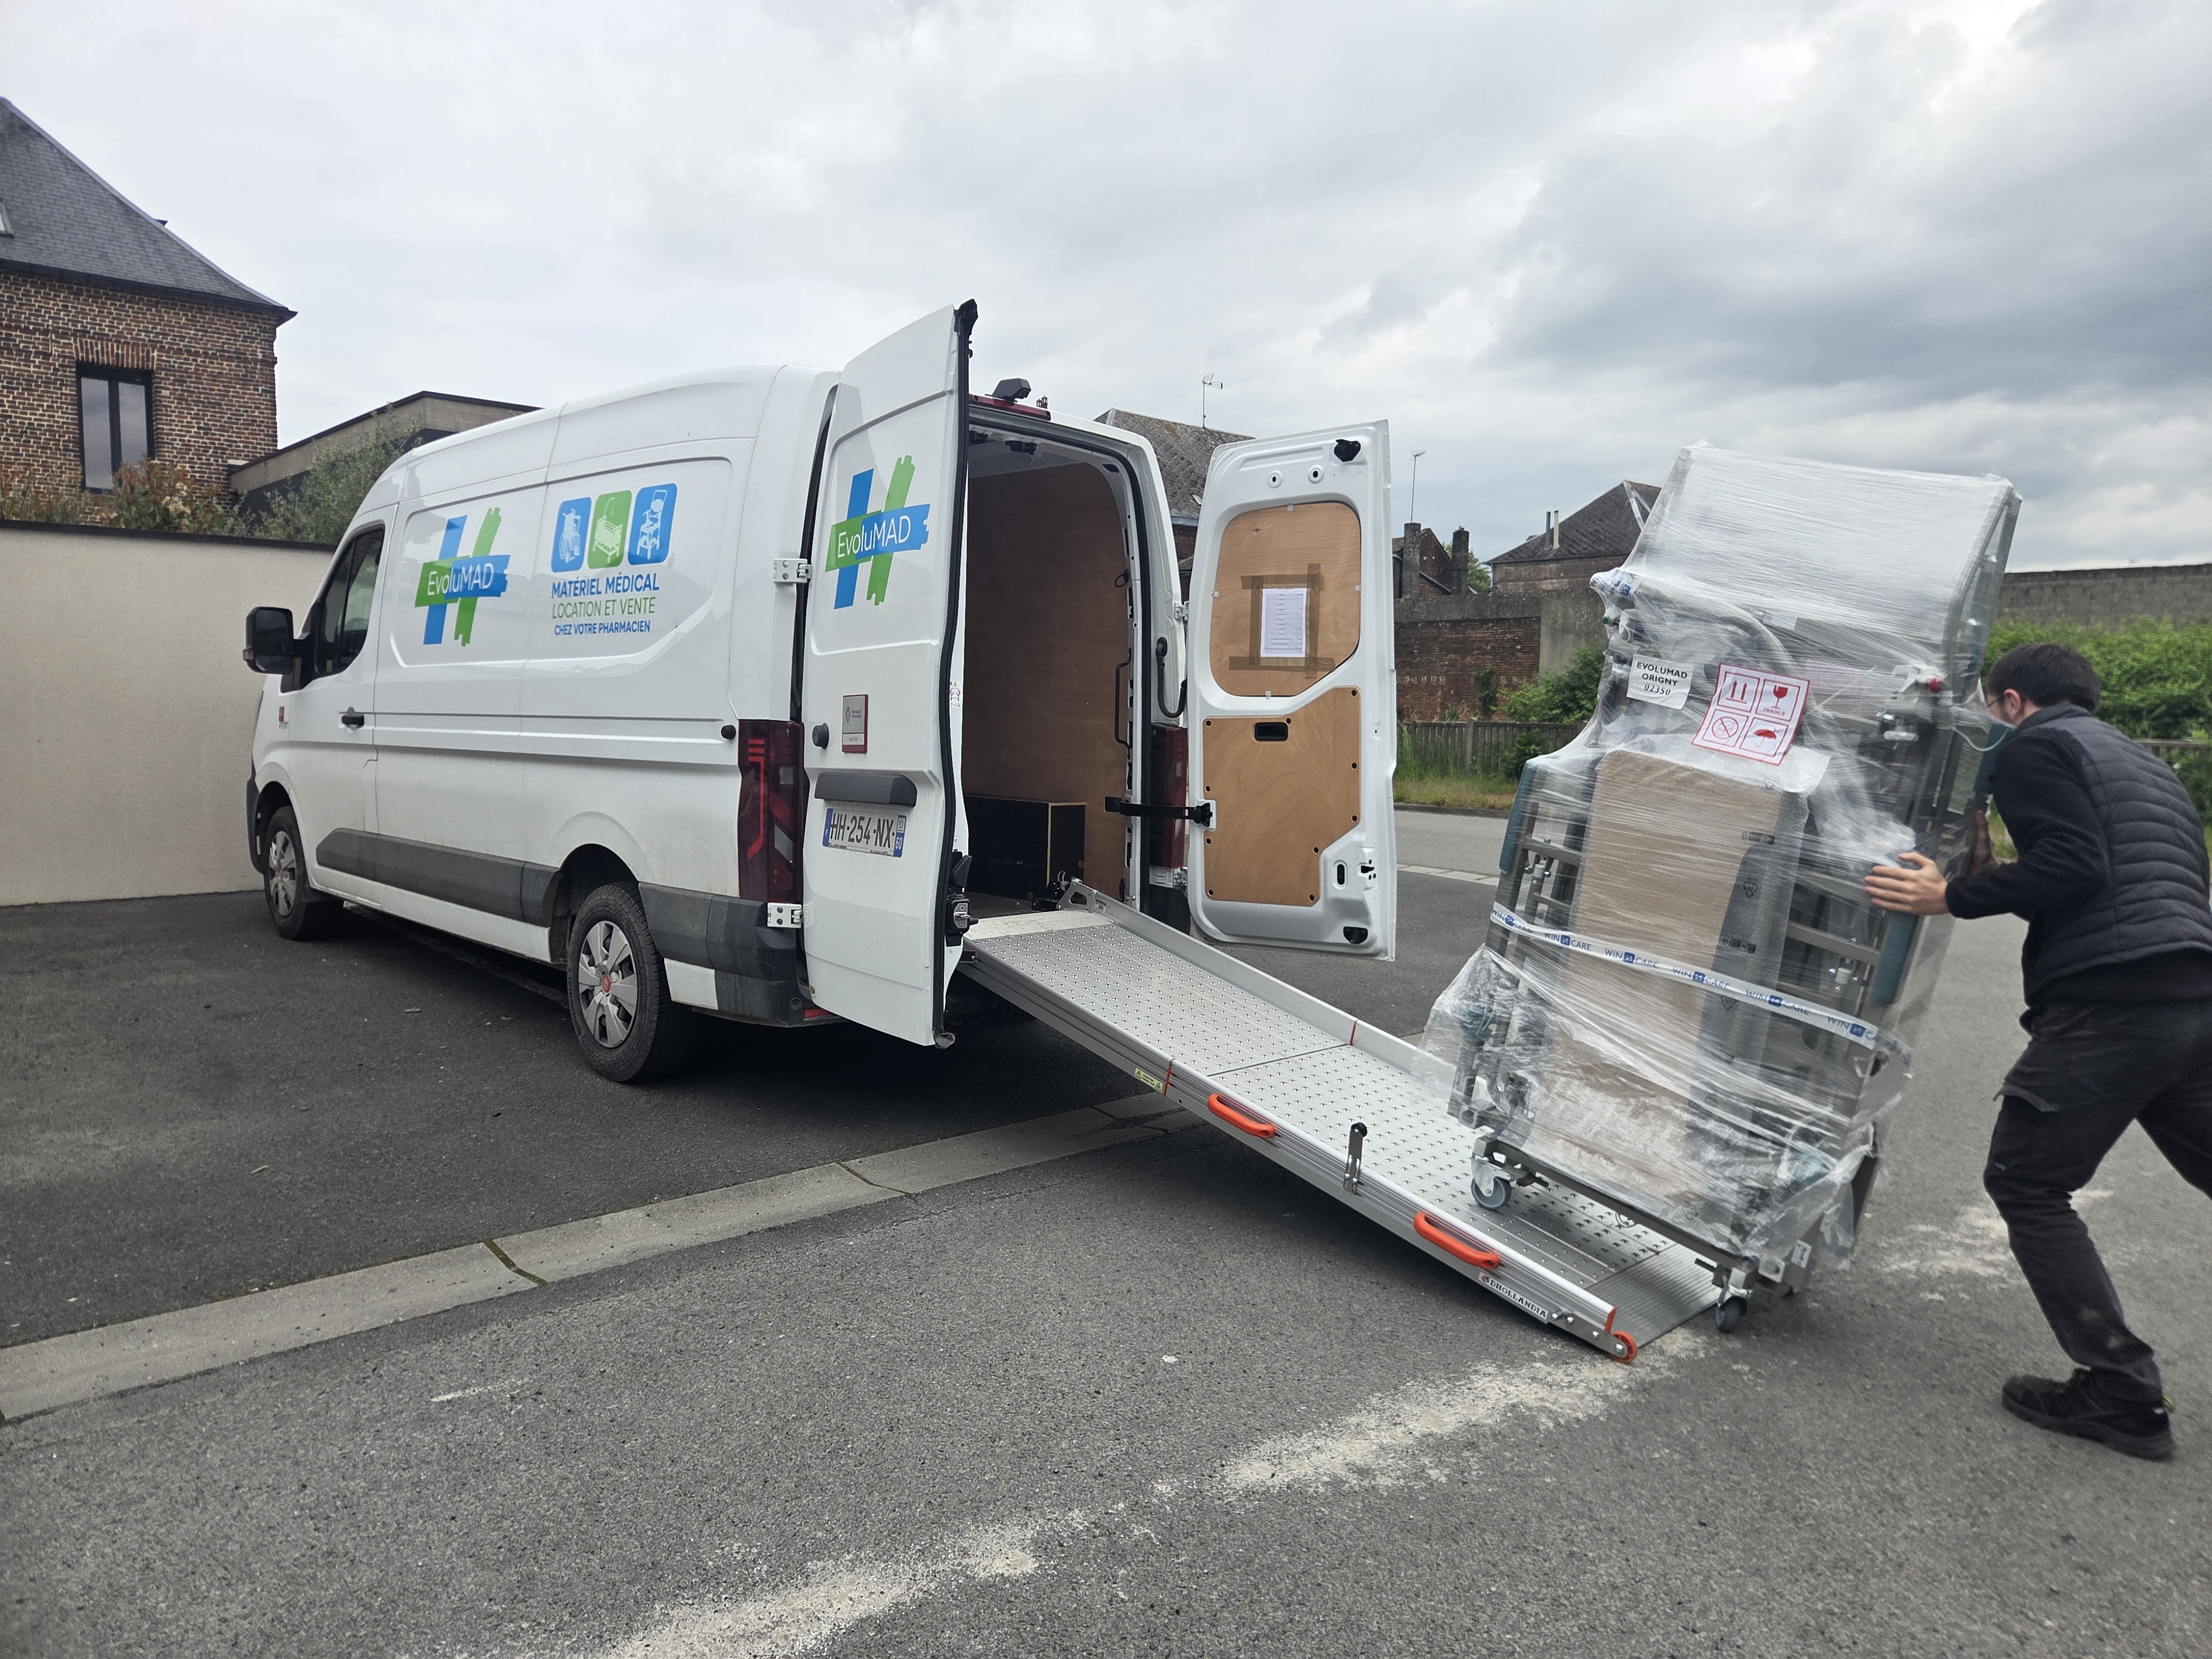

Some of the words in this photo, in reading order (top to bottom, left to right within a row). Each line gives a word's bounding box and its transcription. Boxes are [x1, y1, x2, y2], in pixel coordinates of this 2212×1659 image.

[838, 515, 911, 559] EvoluMAD
[427, 563, 494, 596] EvoluMAD
[551, 575, 602, 599] MATÉRIEL
[605, 571, 660, 594] MÉDICAL
[552, 600, 602, 619] LOCATION
[604, 599, 617, 616] ET
[620, 597, 656, 615] VENTE
[554, 624, 572, 635] CHEZ
[573, 623, 597, 635] VOTRE
[598, 620, 651, 634] PHARMACIEN
[1636, 661, 1688, 679] EVOLUMAD
[1642, 673, 1678, 687] ORIGNY
[1644, 684, 1671, 696] 02350
[1490, 1279, 1546, 1318] DHOLLANDIA
